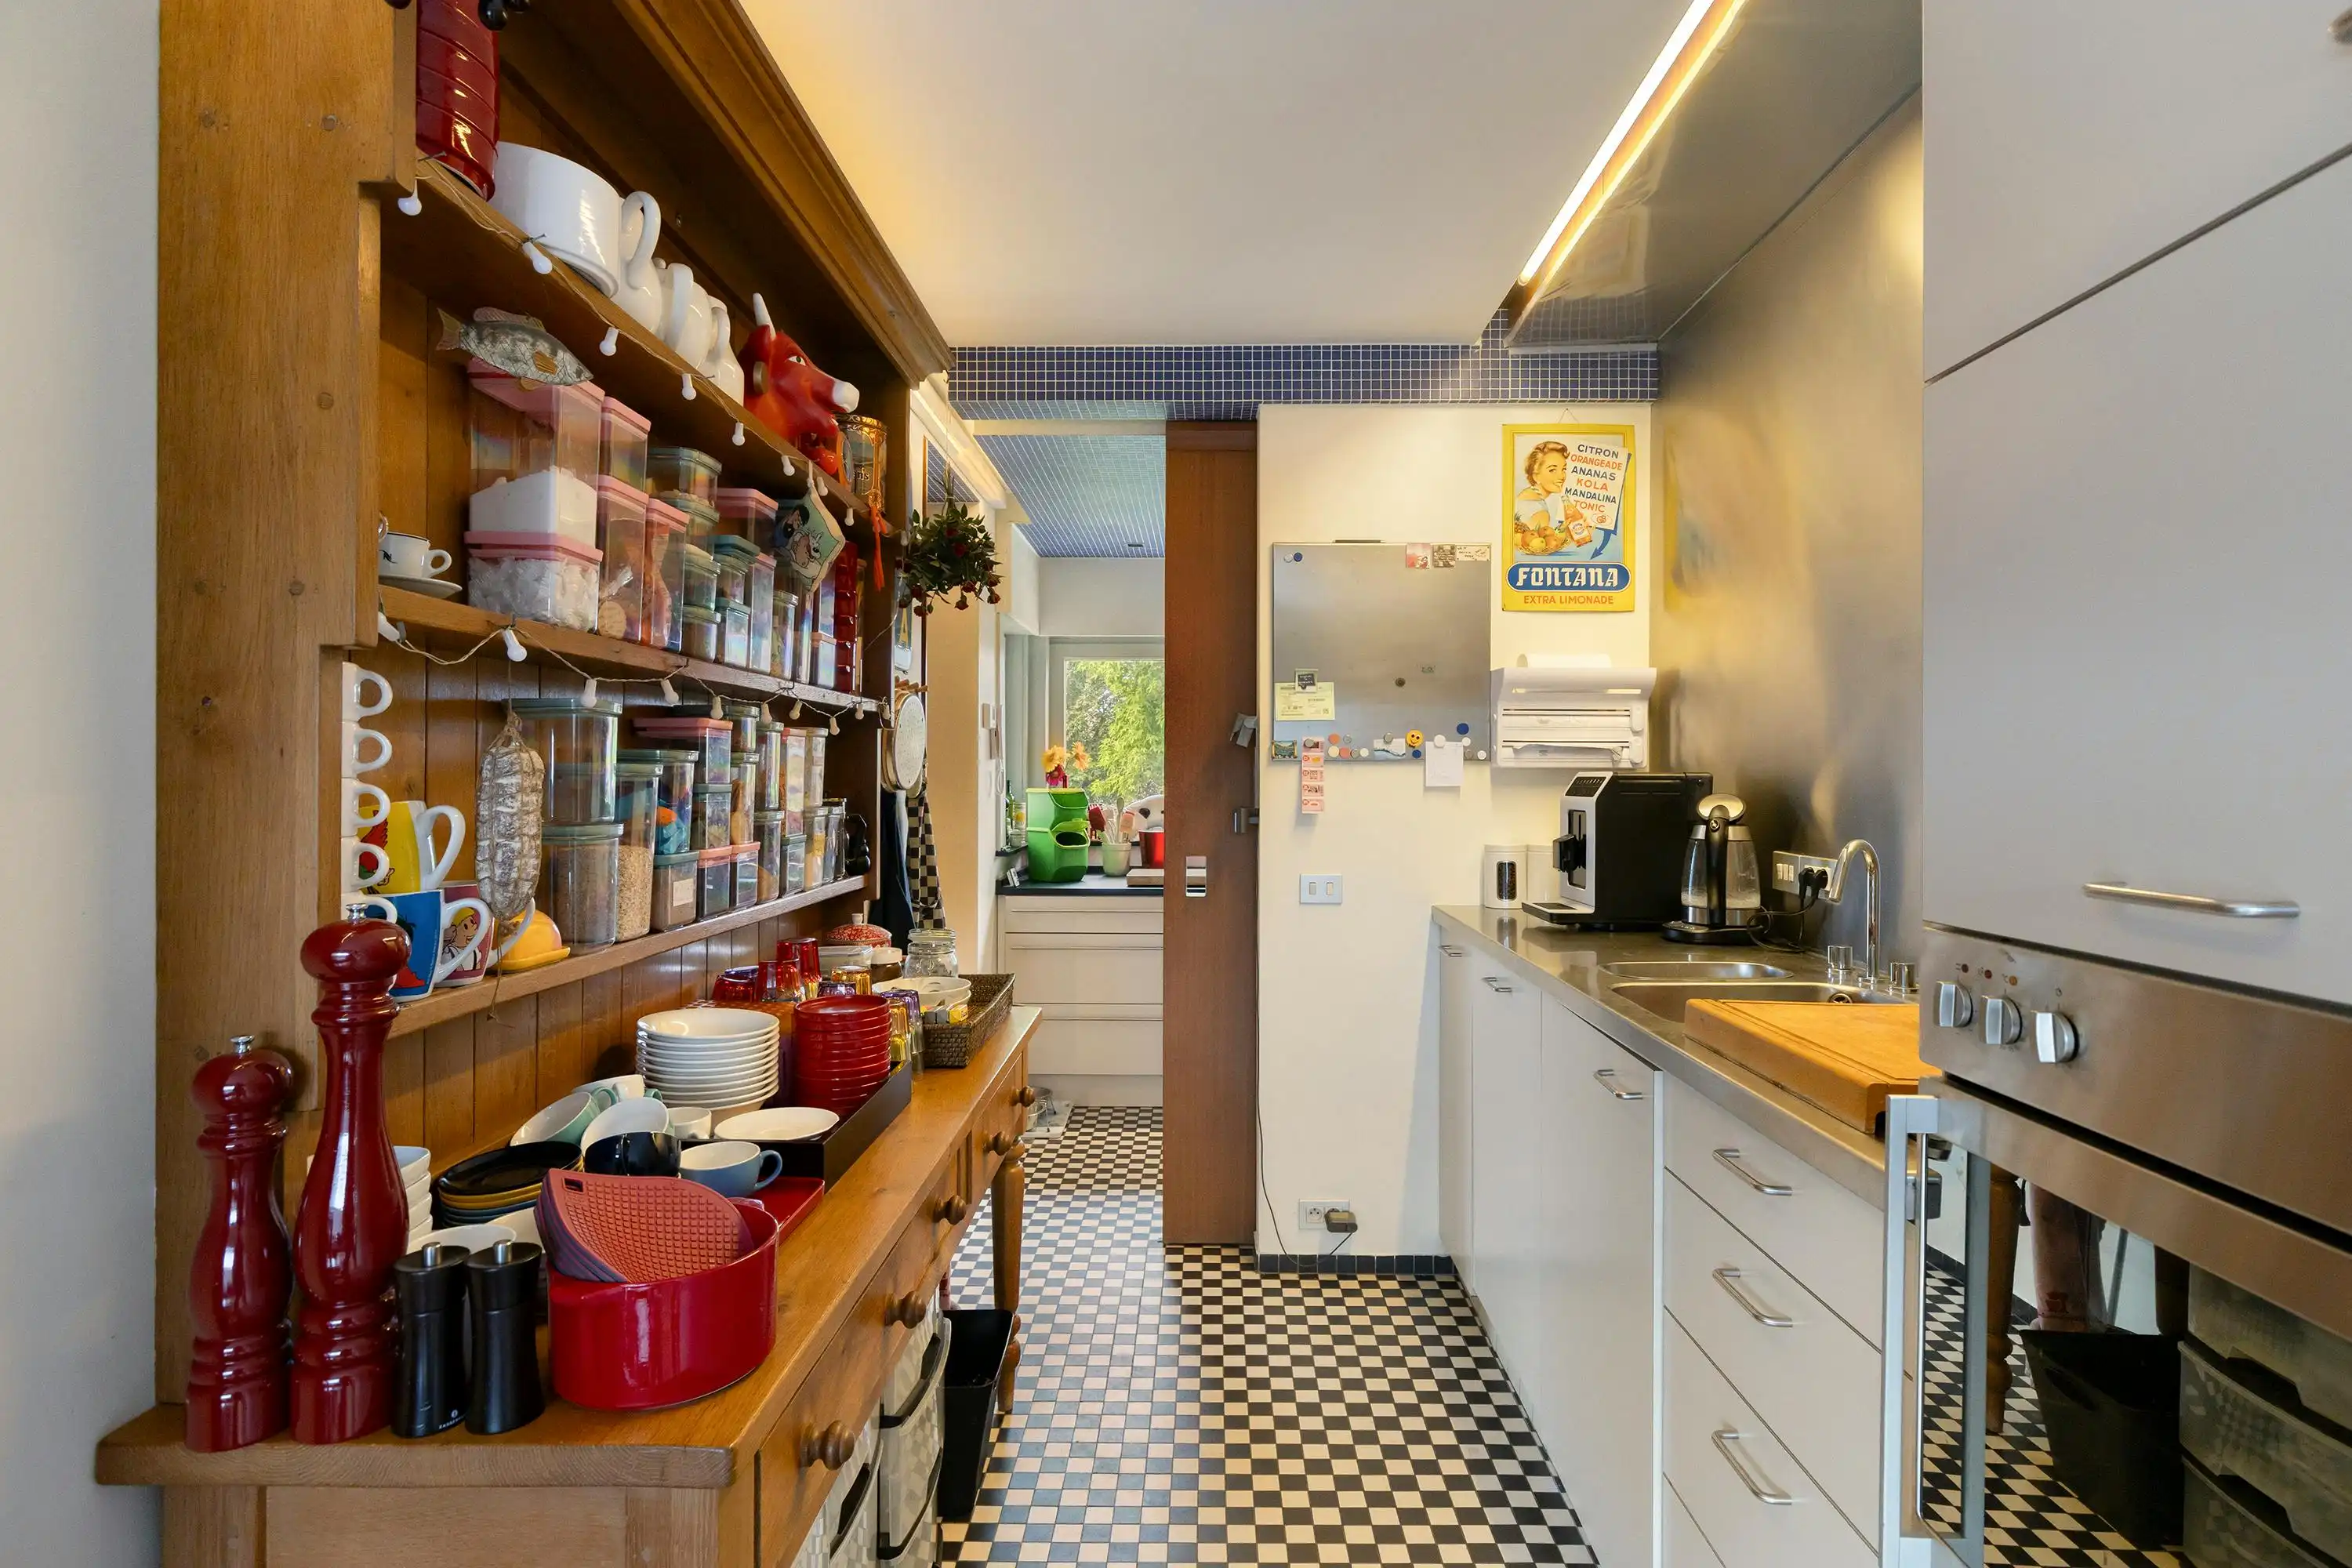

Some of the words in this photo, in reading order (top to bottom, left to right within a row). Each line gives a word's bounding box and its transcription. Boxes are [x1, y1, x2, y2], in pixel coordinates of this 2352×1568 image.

[1577, 444, 1619, 459] CITRON
[1570, 454, 1623, 470] ORANGEADE
[1571, 466, 1617, 481] ANANAS
[1577, 478, 1609, 492] KOLA
[1565, 487, 1617, 504] MANDALINA
[1574, 499, 1606, 513] TONIC
[1515, 567, 1619, 588] FONTANA
[1523, 595, 1556, 604] EXTRA
[1559, 595, 1614, 604] LIMONADE
